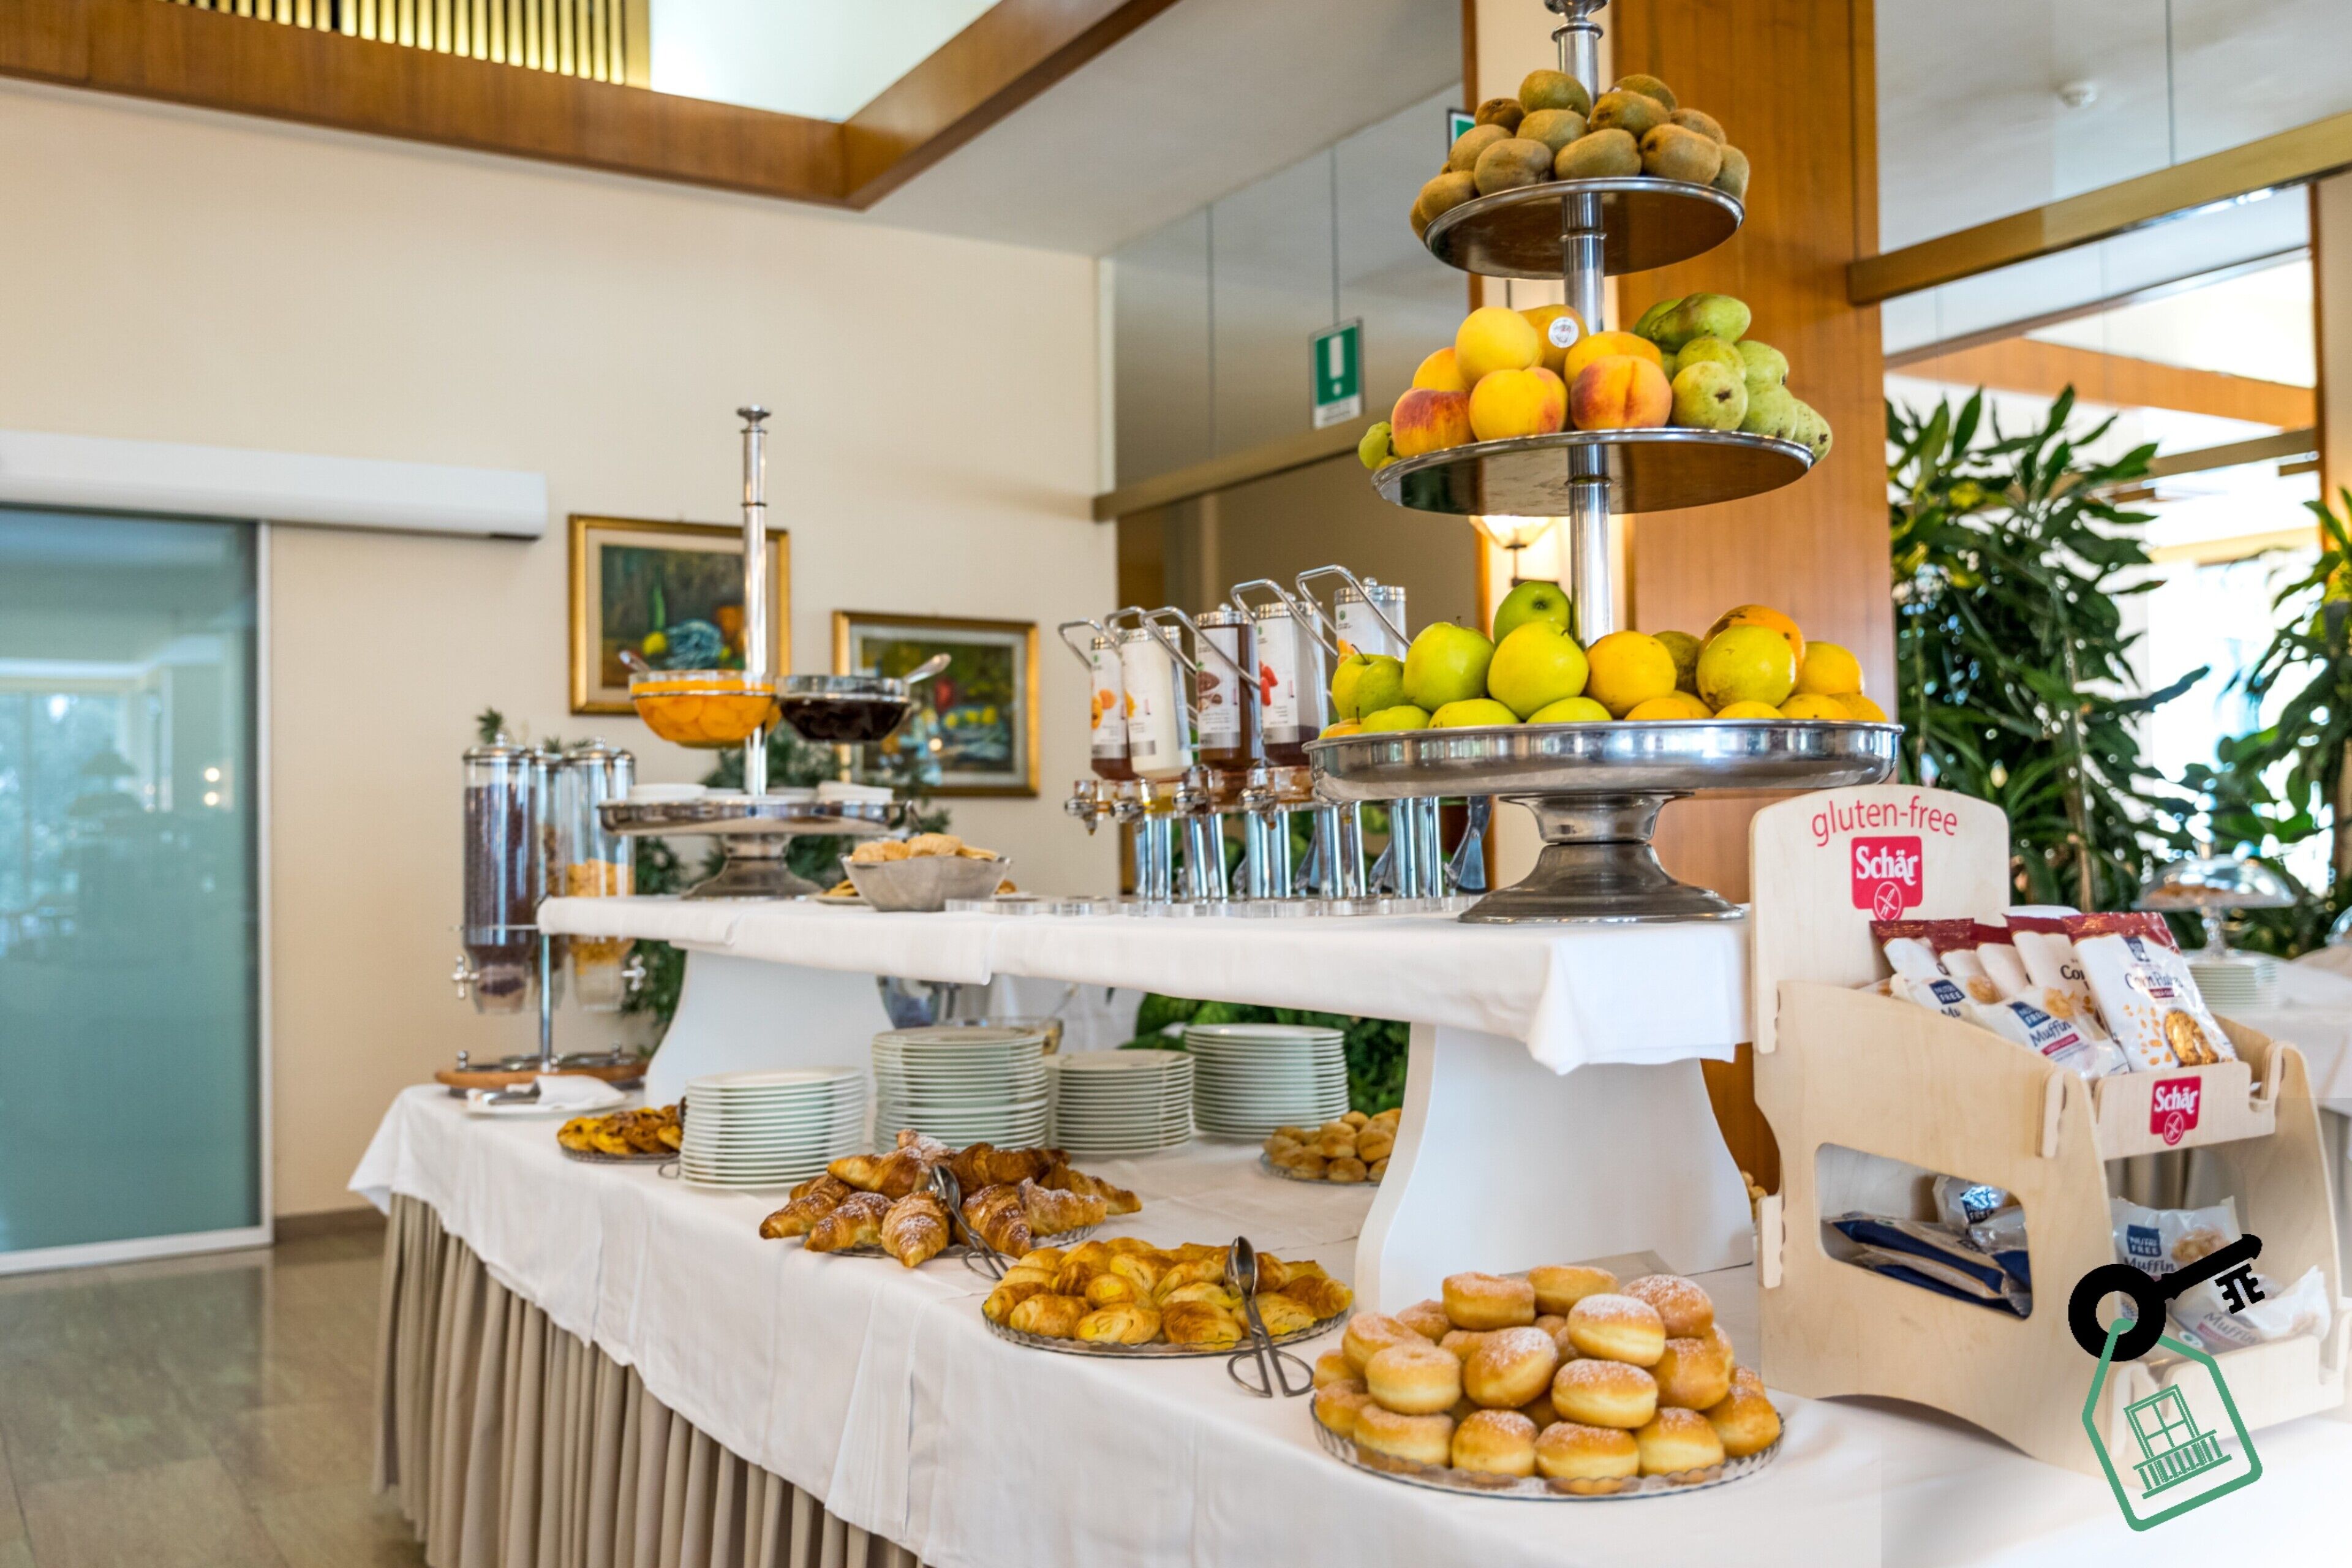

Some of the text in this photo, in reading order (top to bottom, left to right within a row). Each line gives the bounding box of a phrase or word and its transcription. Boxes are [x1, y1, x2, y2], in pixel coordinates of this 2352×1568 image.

[1811, 795, 1958, 847] gluten-free
[1856, 845, 1919, 886] Schär
[2029, 1019, 2072, 1047] Muffin
[2154, 1085, 2199, 1115] Schär
[2131, 1244, 2159, 1254] FREE
[2124, 1256, 2176, 1273] Muffin
